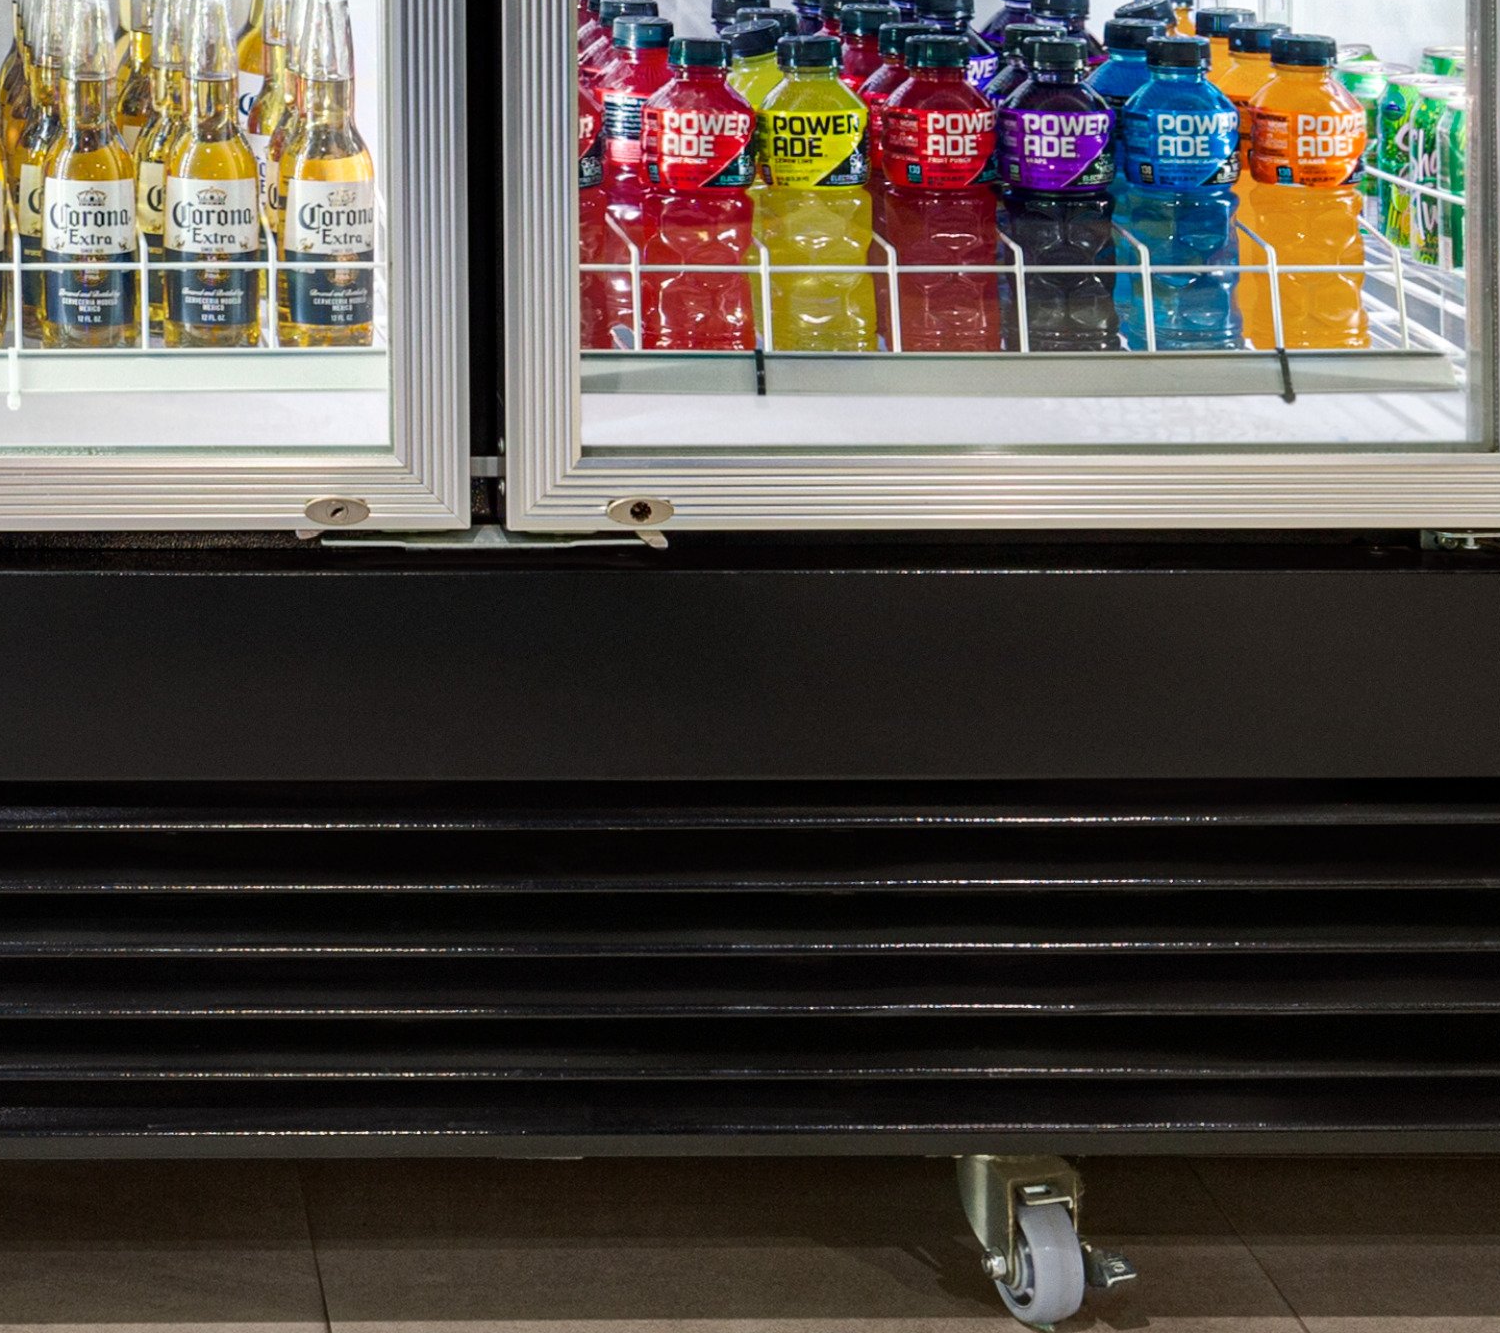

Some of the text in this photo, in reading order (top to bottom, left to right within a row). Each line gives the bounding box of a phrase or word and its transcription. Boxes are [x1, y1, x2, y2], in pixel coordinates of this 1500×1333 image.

[773, 114, 860, 134] POWER
[1023, 114, 1110, 136] POWER
[773, 136, 822, 158] ADE
[1023, 136, 1076, 158] ADE
[173, 202, 252, 232] Corona
[191, 230, 236, 245] Extra
